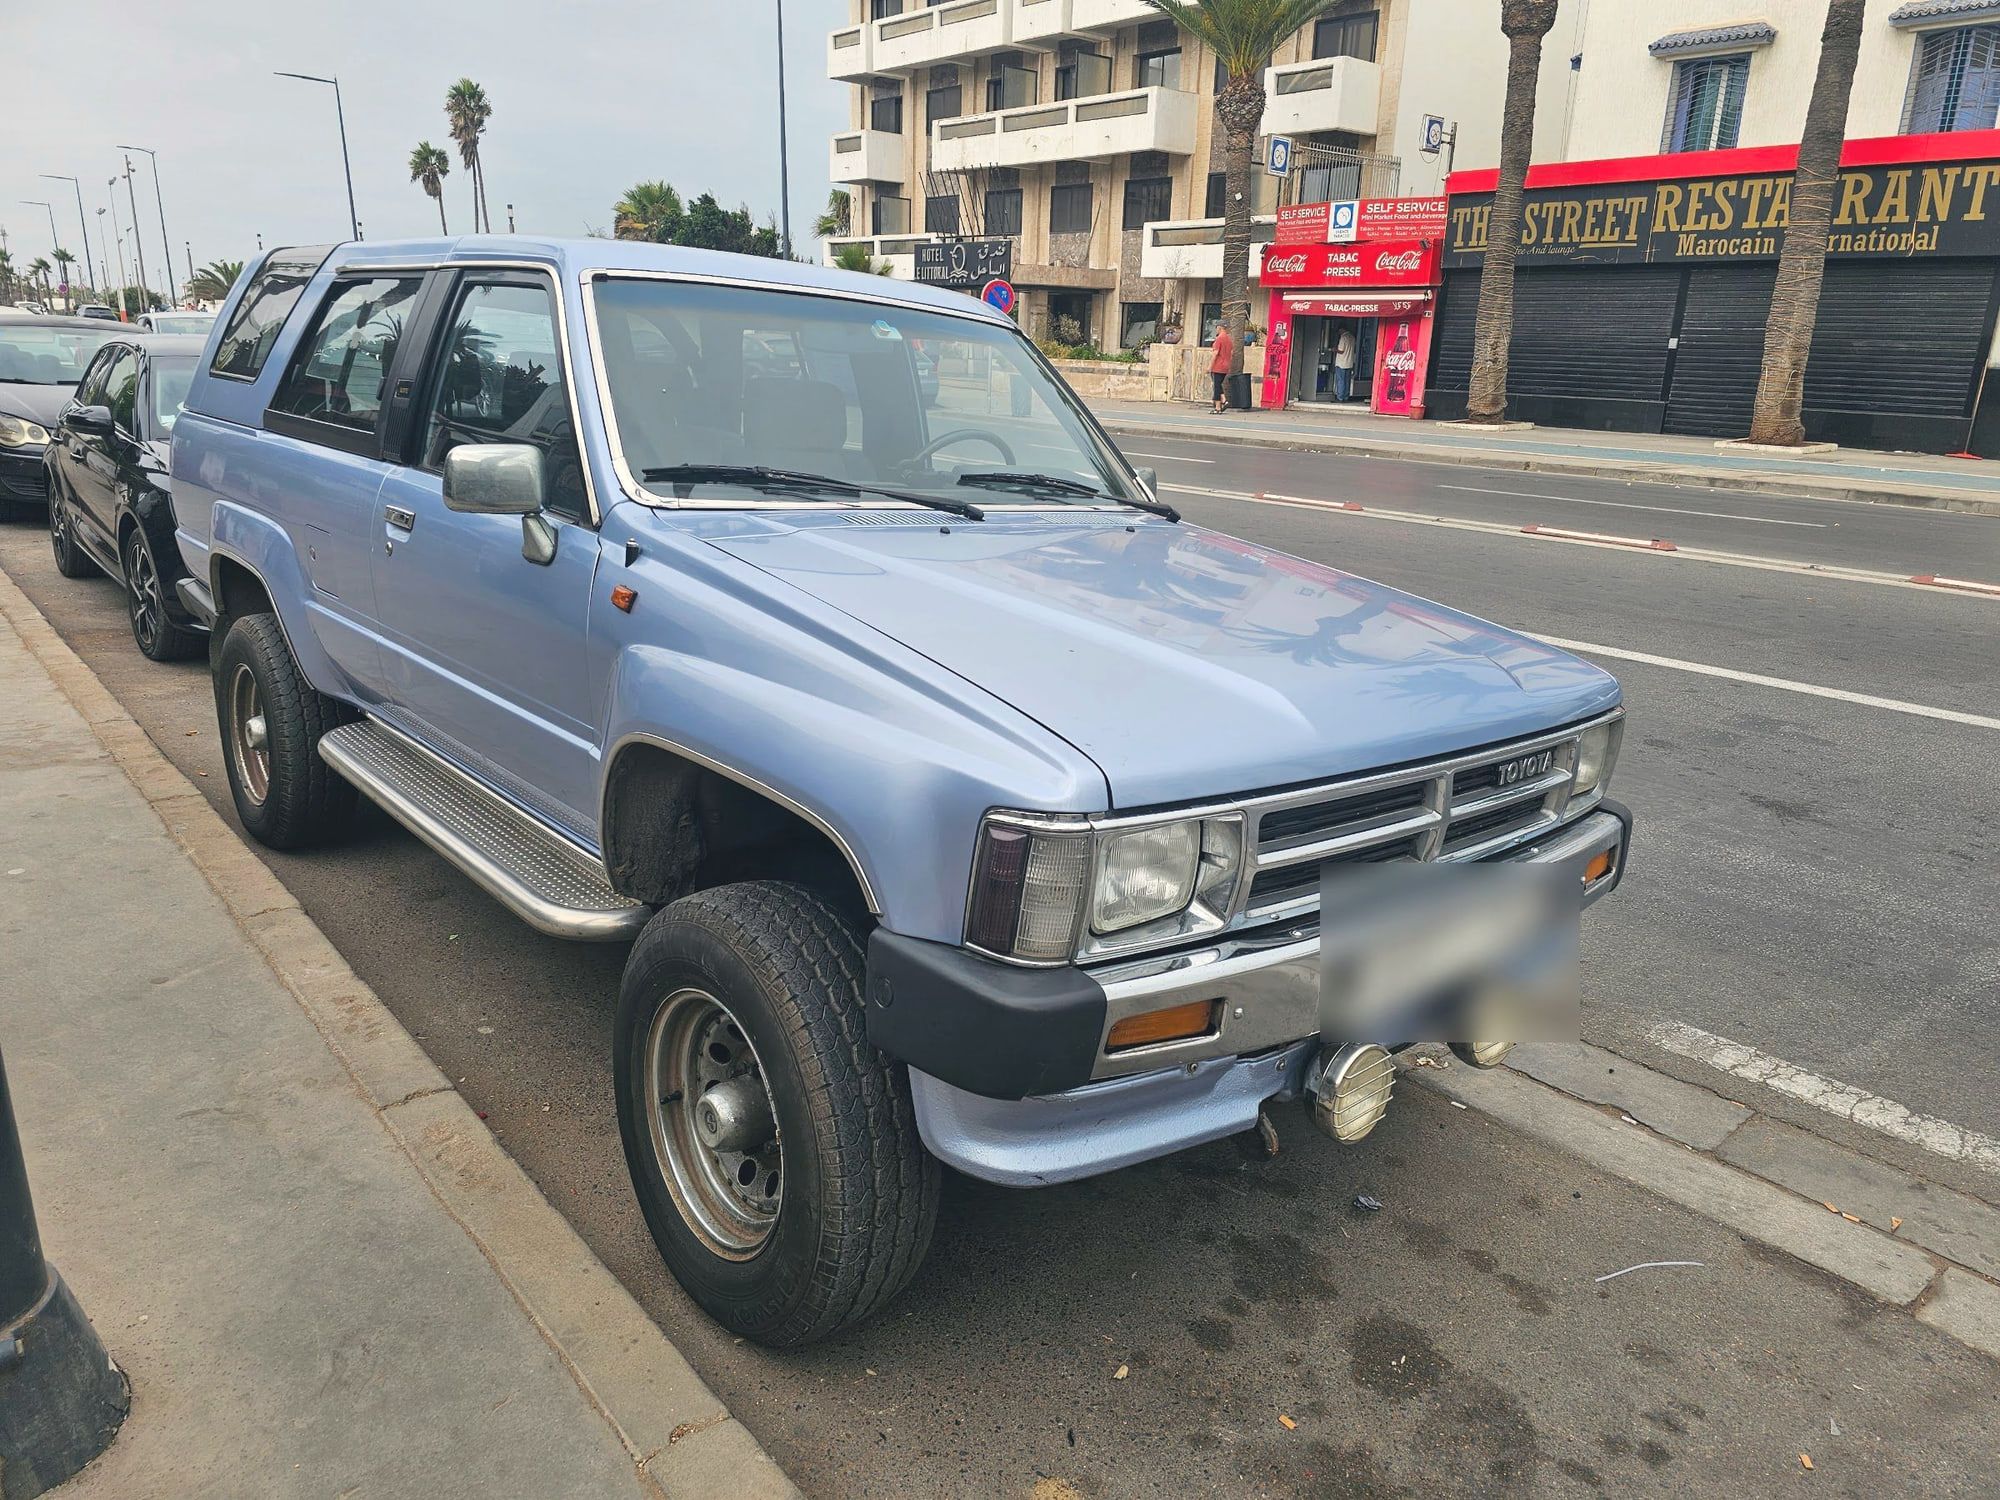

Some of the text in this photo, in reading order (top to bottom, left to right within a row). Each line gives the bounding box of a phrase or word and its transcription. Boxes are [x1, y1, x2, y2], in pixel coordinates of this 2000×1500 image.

[1367, 201, 1446, 213] SELF SERVICE
[1652, 165, 2000, 232] RESTARANT
[1281, 207, 1326, 220] SELF SERVICE
[1453, 196, 1648, 247] TH STREET
[1675, 230, 1775, 256] Marocain
[1826, 225, 1939, 252] rnational
[921, 248, 944, 262] HOTEL
[977, 242, 1006, 259] فندق
[1328, 253, 1359, 262] TABAC
[1267, 254, 1308, 272] Coca-Cola
[1375, 250, 1423, 270] Coca-Cola
[921, 266, 949, 280] LITTORAL
[970, 260, 1005, 280] الساحل
[1325, 303, 1379, 312] TABAC-PRESSE
[1499, 751, 1553, 786] TOYOTA
